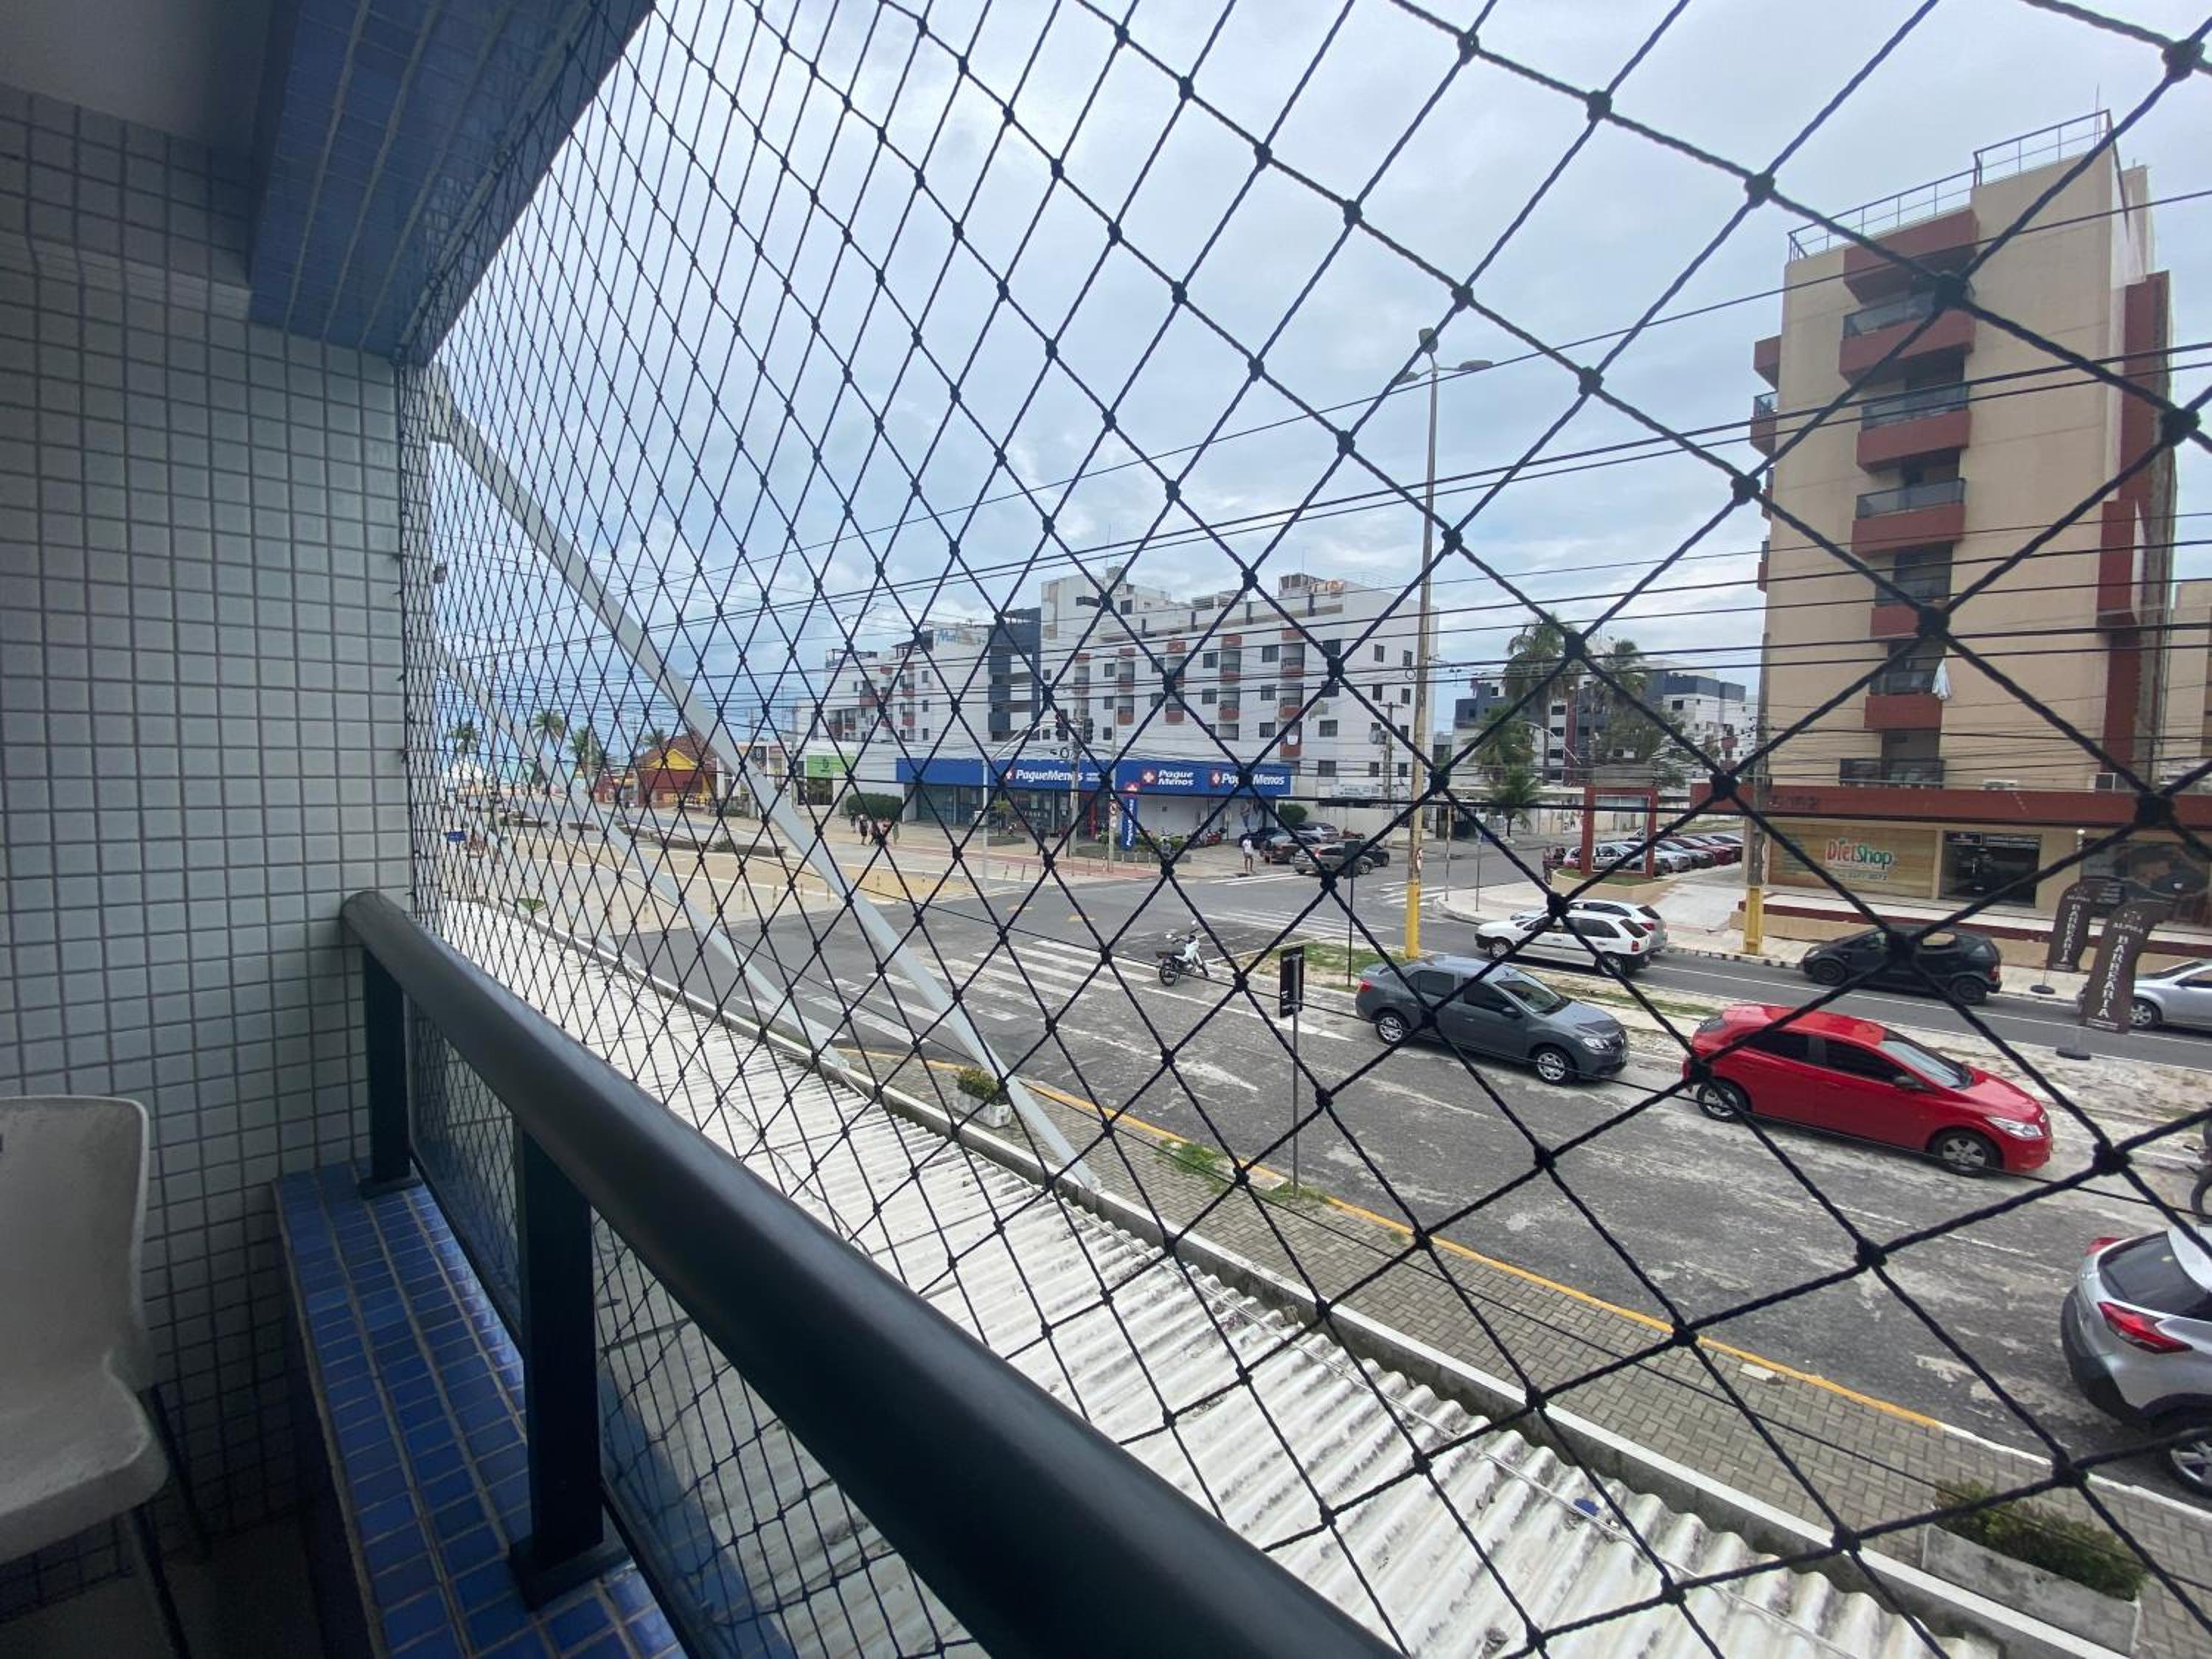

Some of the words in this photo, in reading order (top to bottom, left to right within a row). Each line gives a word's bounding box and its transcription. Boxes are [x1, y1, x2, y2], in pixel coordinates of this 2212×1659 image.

[1158, 769, 1194, 779] Pague
[1158, 778, 1194, 786] Menos
[2098, 934, 2129, 1018] BARBEARIA
